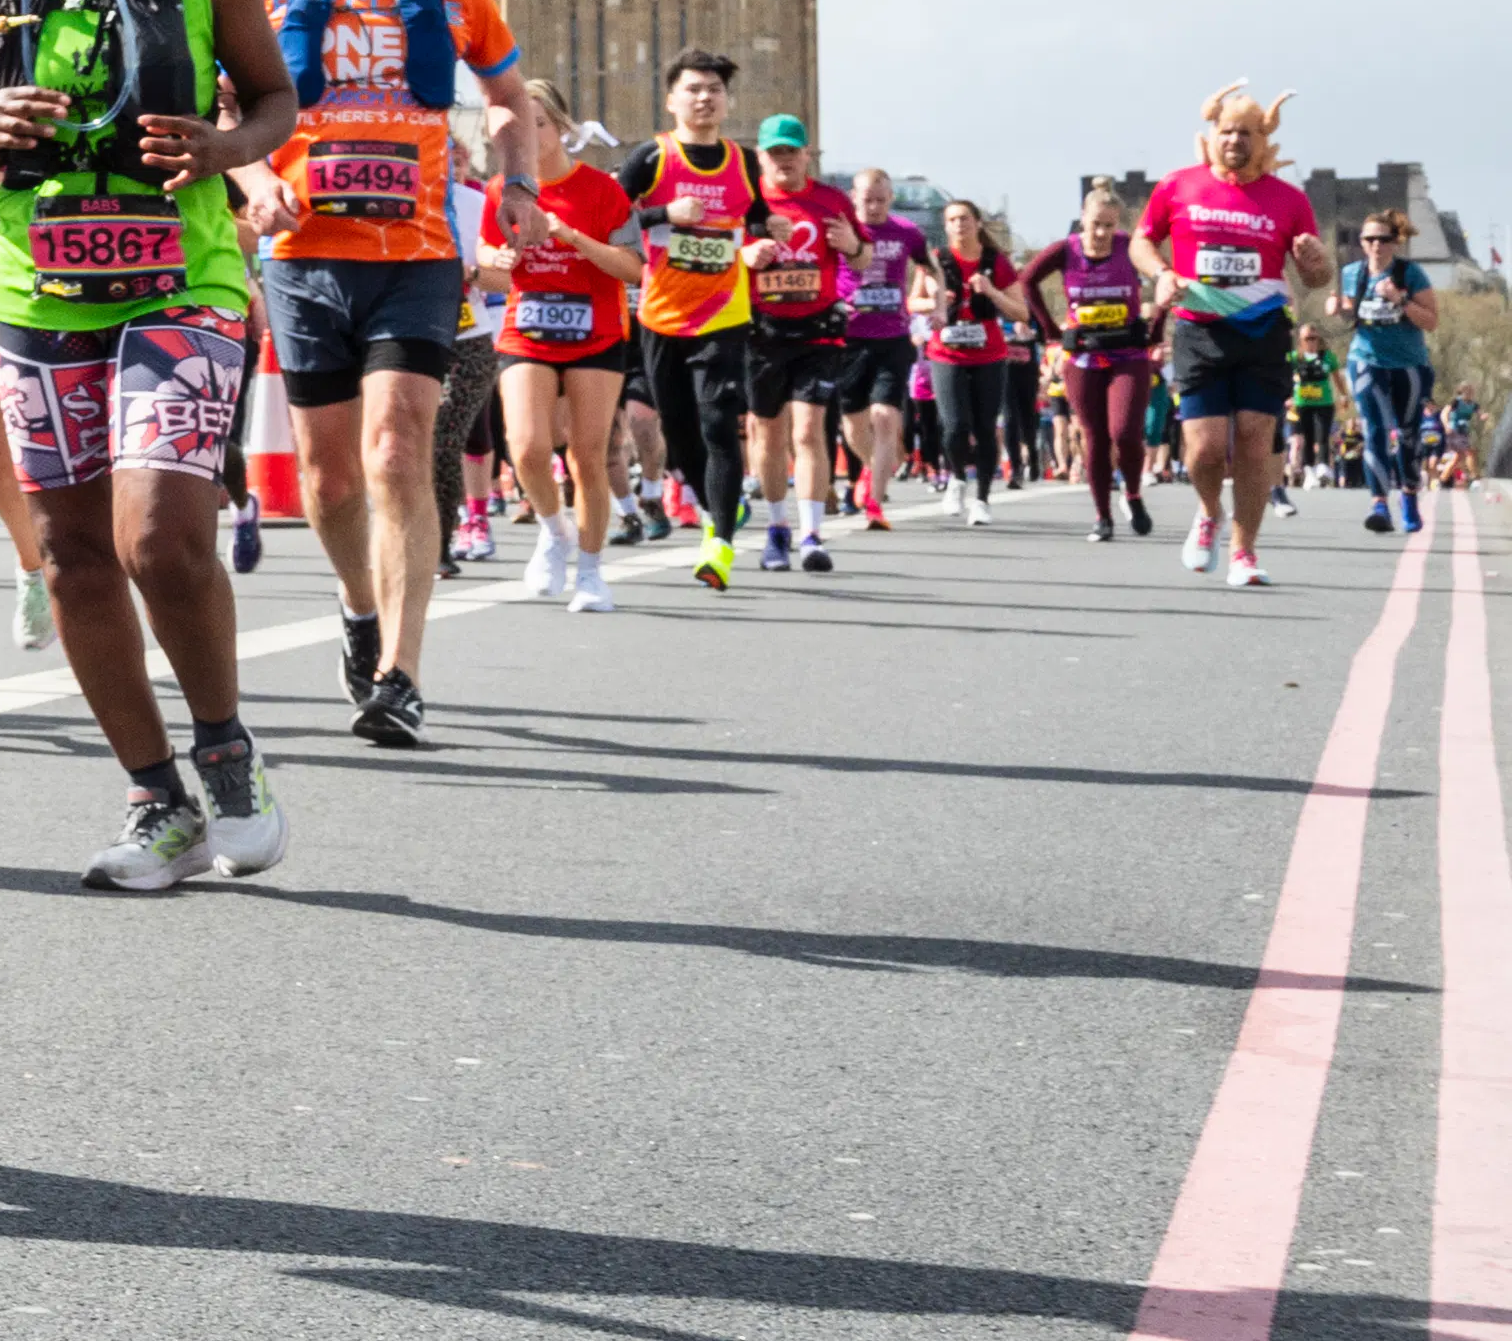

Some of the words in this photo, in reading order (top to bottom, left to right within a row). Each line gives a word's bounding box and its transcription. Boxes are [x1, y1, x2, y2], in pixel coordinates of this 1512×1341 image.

[314, 163, 413, 191] 15494
[80, 199, 121, 212] BABS
[39, 226, 171, 266] 15867
[679, 239, 725, 259] 6350
[521, 306, 587, 325] 21907
